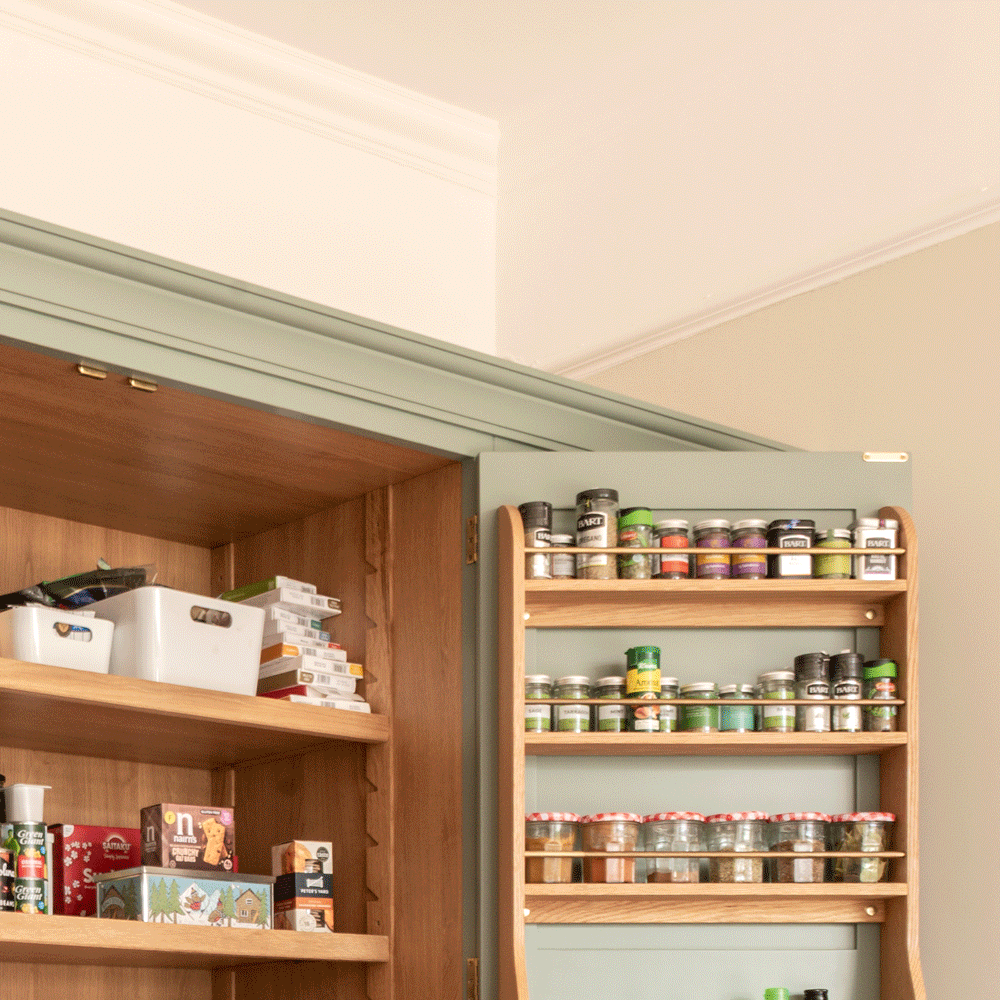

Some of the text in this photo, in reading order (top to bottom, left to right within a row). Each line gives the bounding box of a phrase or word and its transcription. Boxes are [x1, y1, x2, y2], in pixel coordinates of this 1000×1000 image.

[577, 516, 605, 528] BART
[783, 539, 807, 548] BART
[866, 539, 890, 548] BART
[16, 828, 45, 839] Green
[18, 836, 45, 847] Giant
[14, 884, 43, 895] Green
[15, 890, 44, 901] Giant
